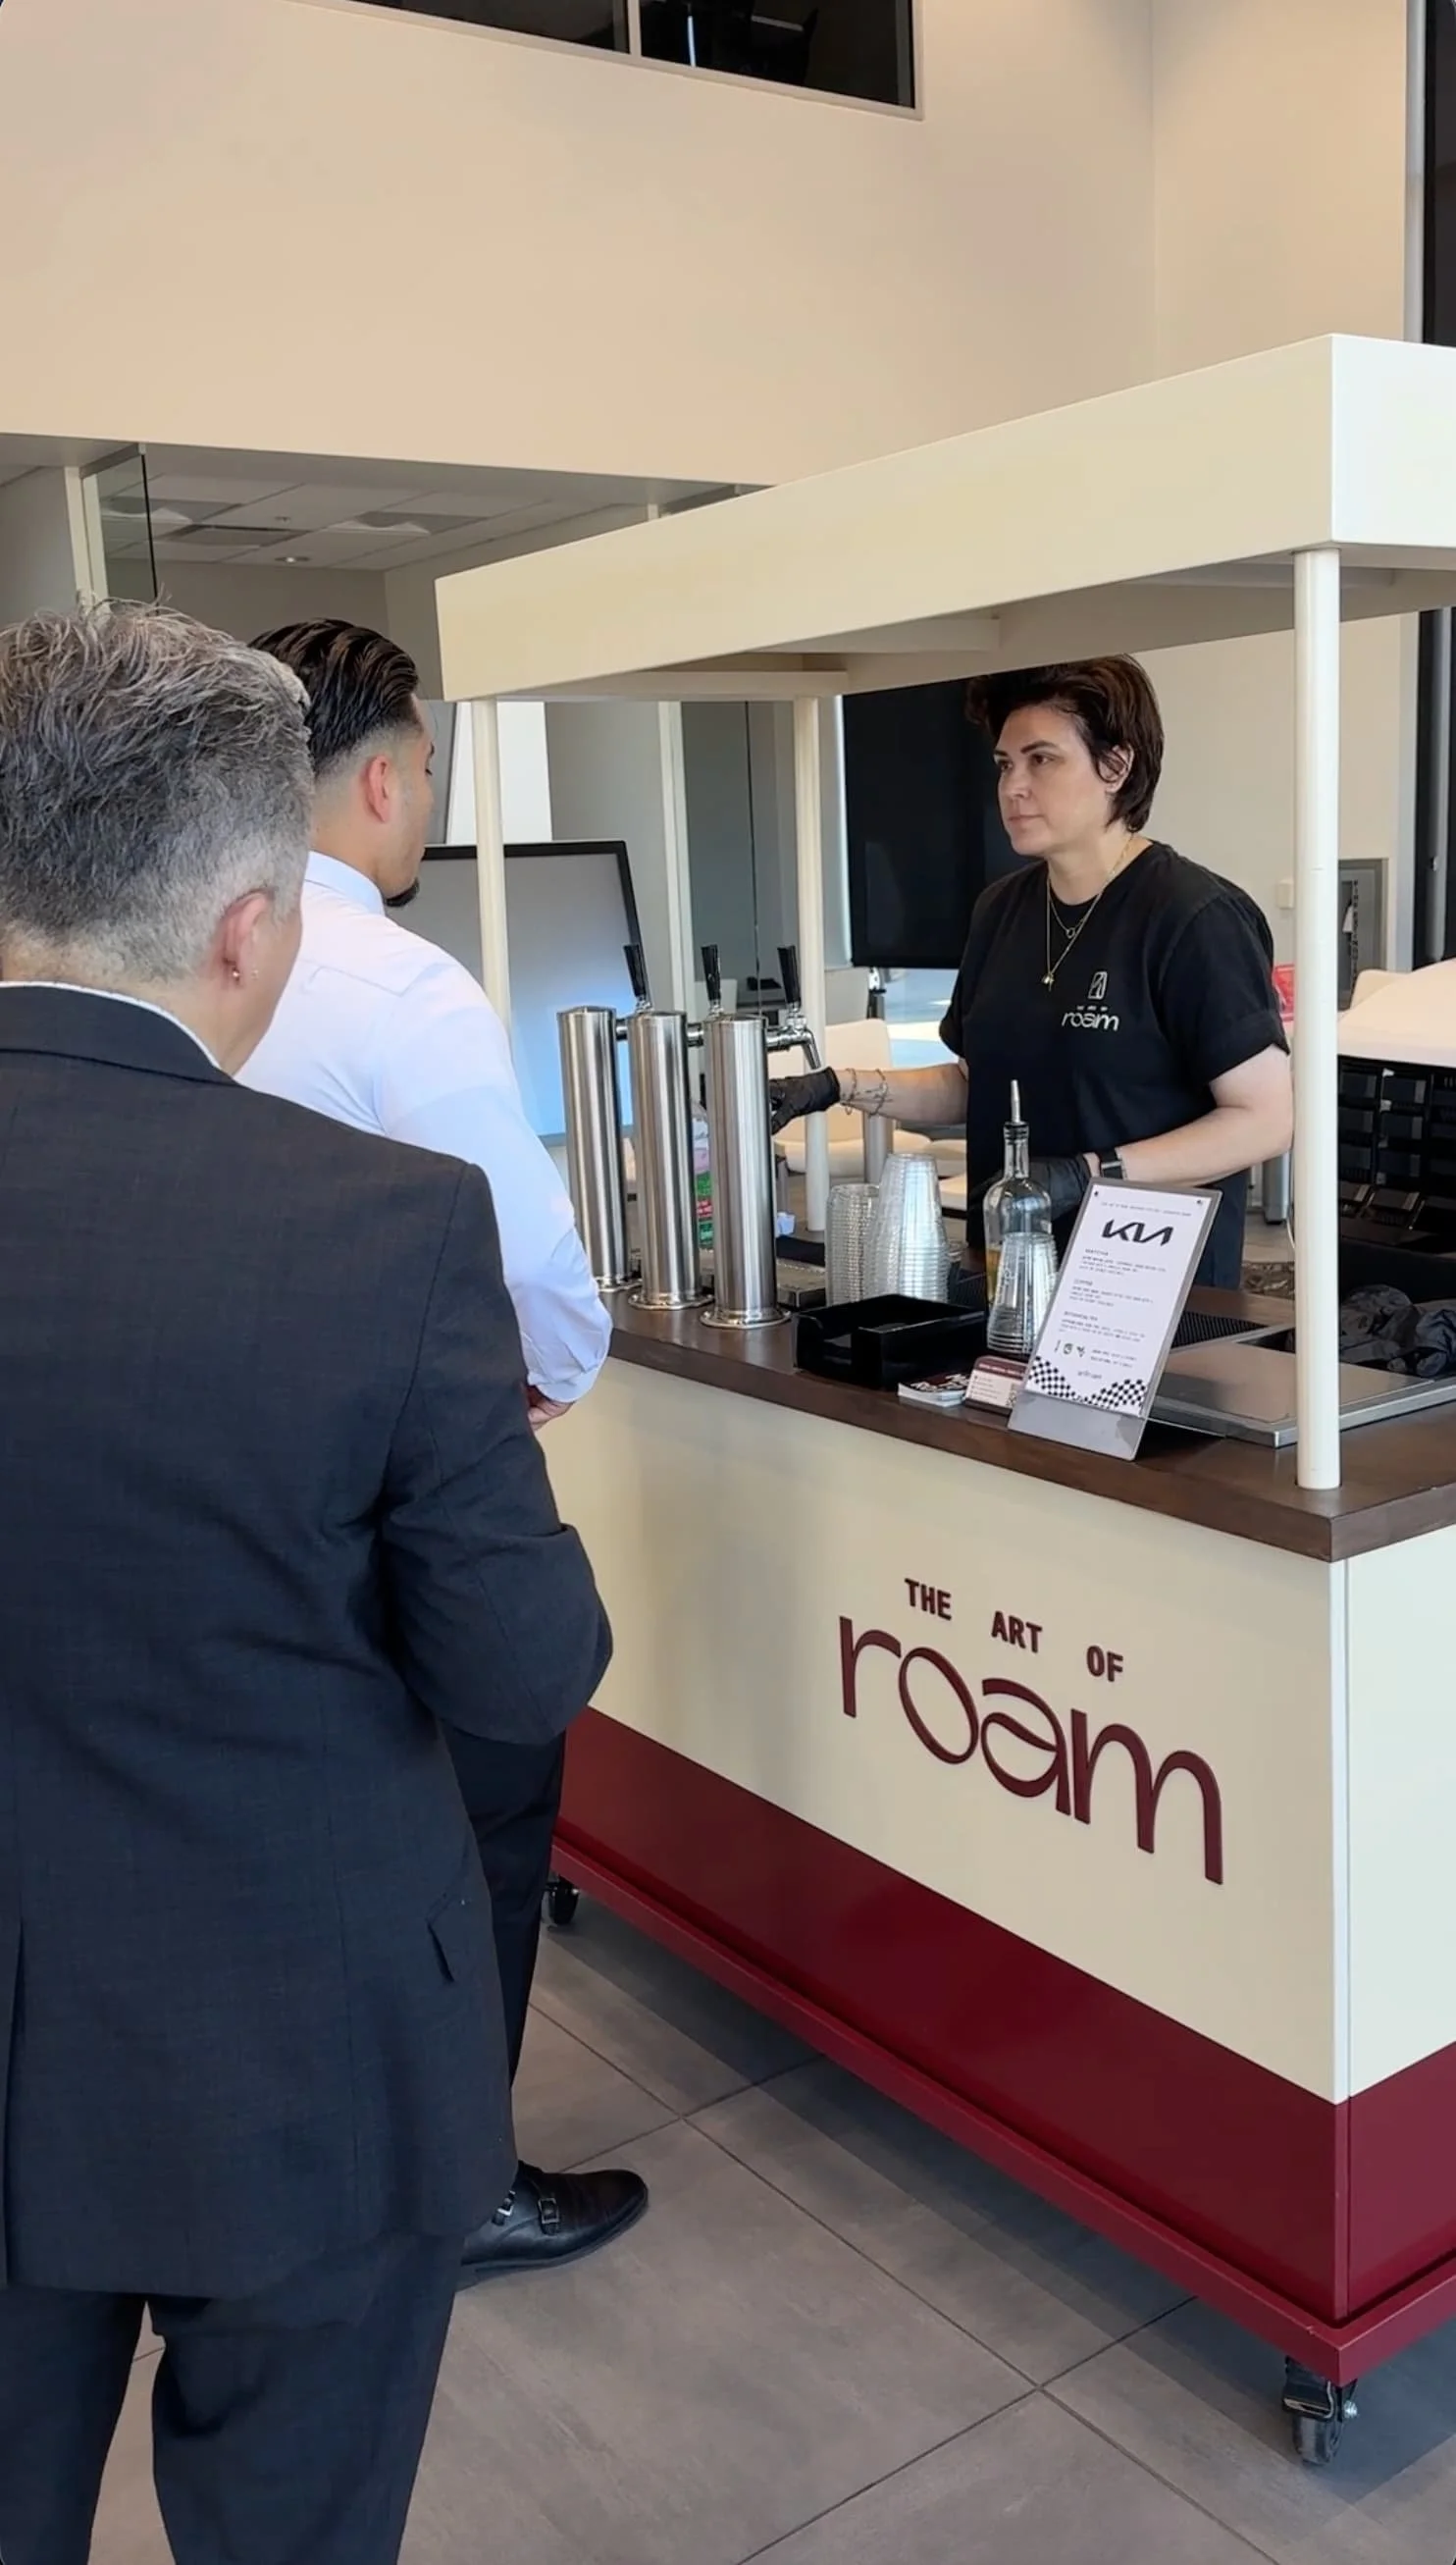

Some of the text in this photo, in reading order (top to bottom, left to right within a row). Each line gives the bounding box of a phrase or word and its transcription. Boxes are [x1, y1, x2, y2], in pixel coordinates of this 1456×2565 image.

[1062, 1012, 1119, 1031] roam
[1101, 1219, 1174, 1246] KIA
[905, 1578, 1123, 1682] THE ART OF
[839, 1615, 1223, 1885] roam
